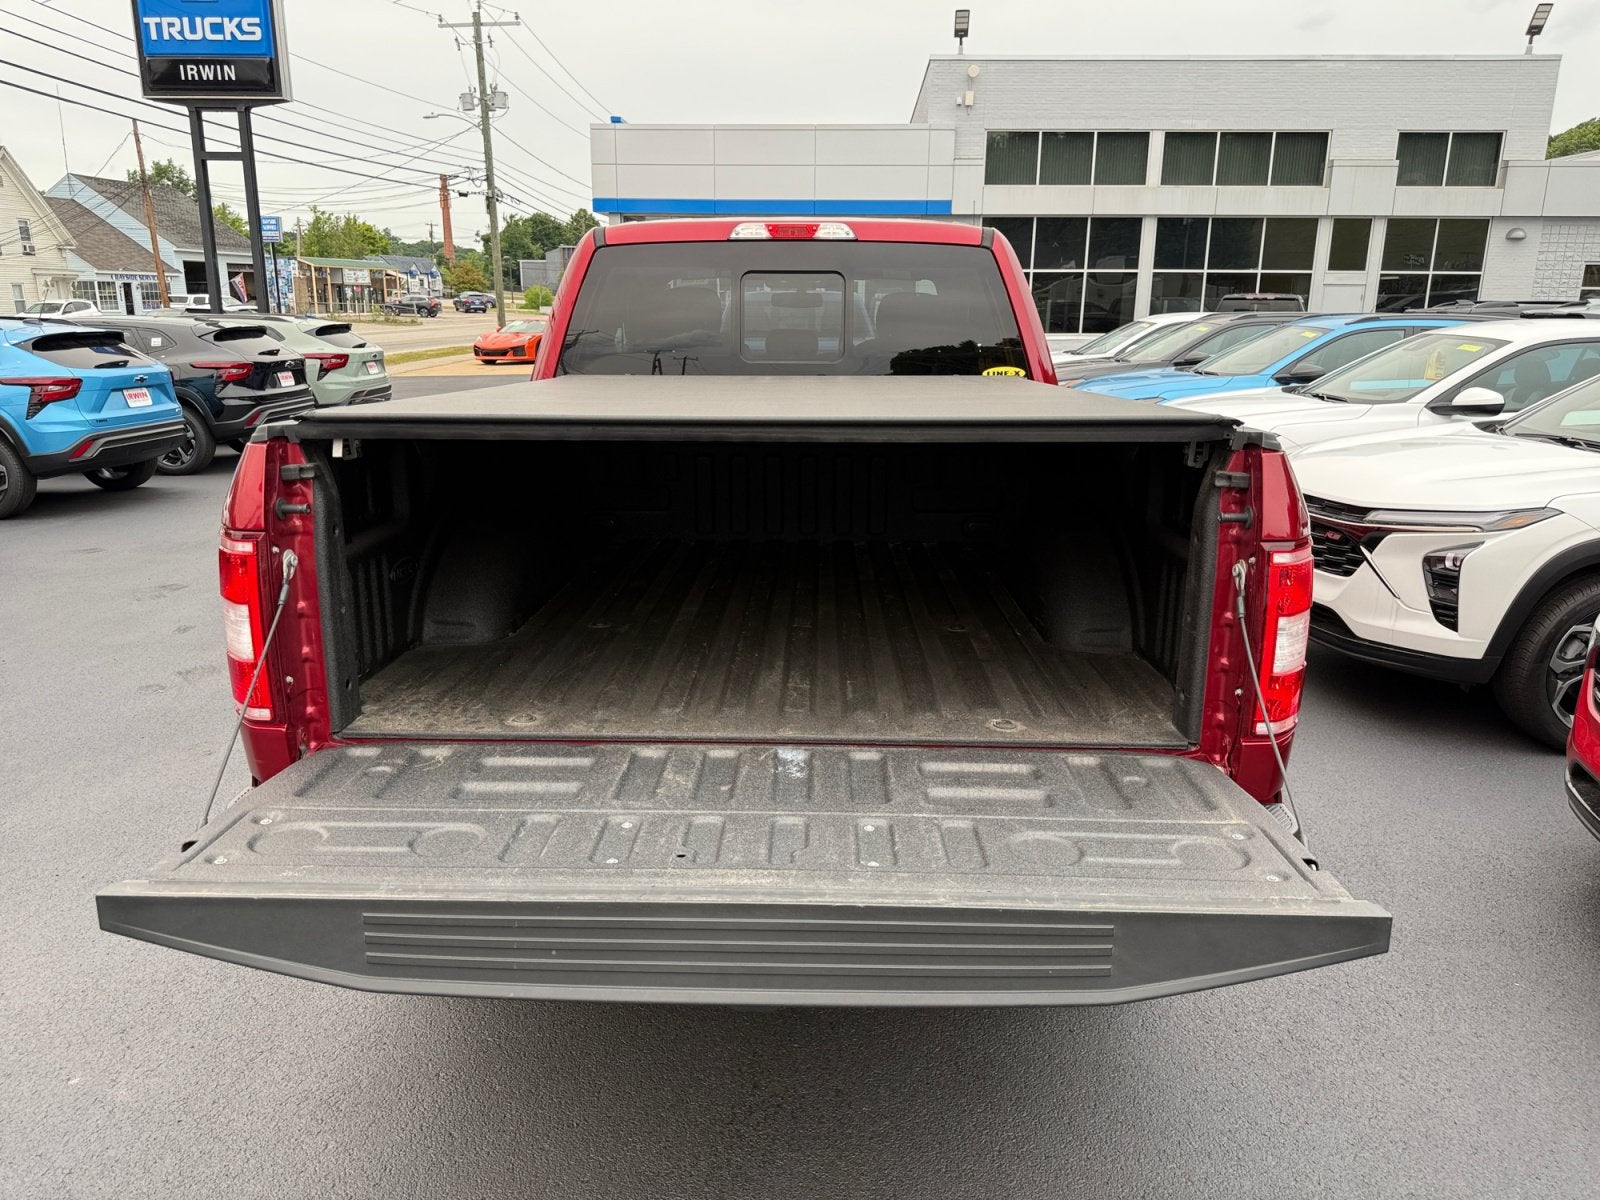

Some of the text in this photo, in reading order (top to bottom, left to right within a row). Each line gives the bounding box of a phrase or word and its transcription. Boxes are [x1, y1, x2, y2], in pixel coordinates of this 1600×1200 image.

[143, 16, 262, 41] TRUCKS
[179, 64, 236, 81] IRWIN
[126, 391, 149, 401] IRWIN
